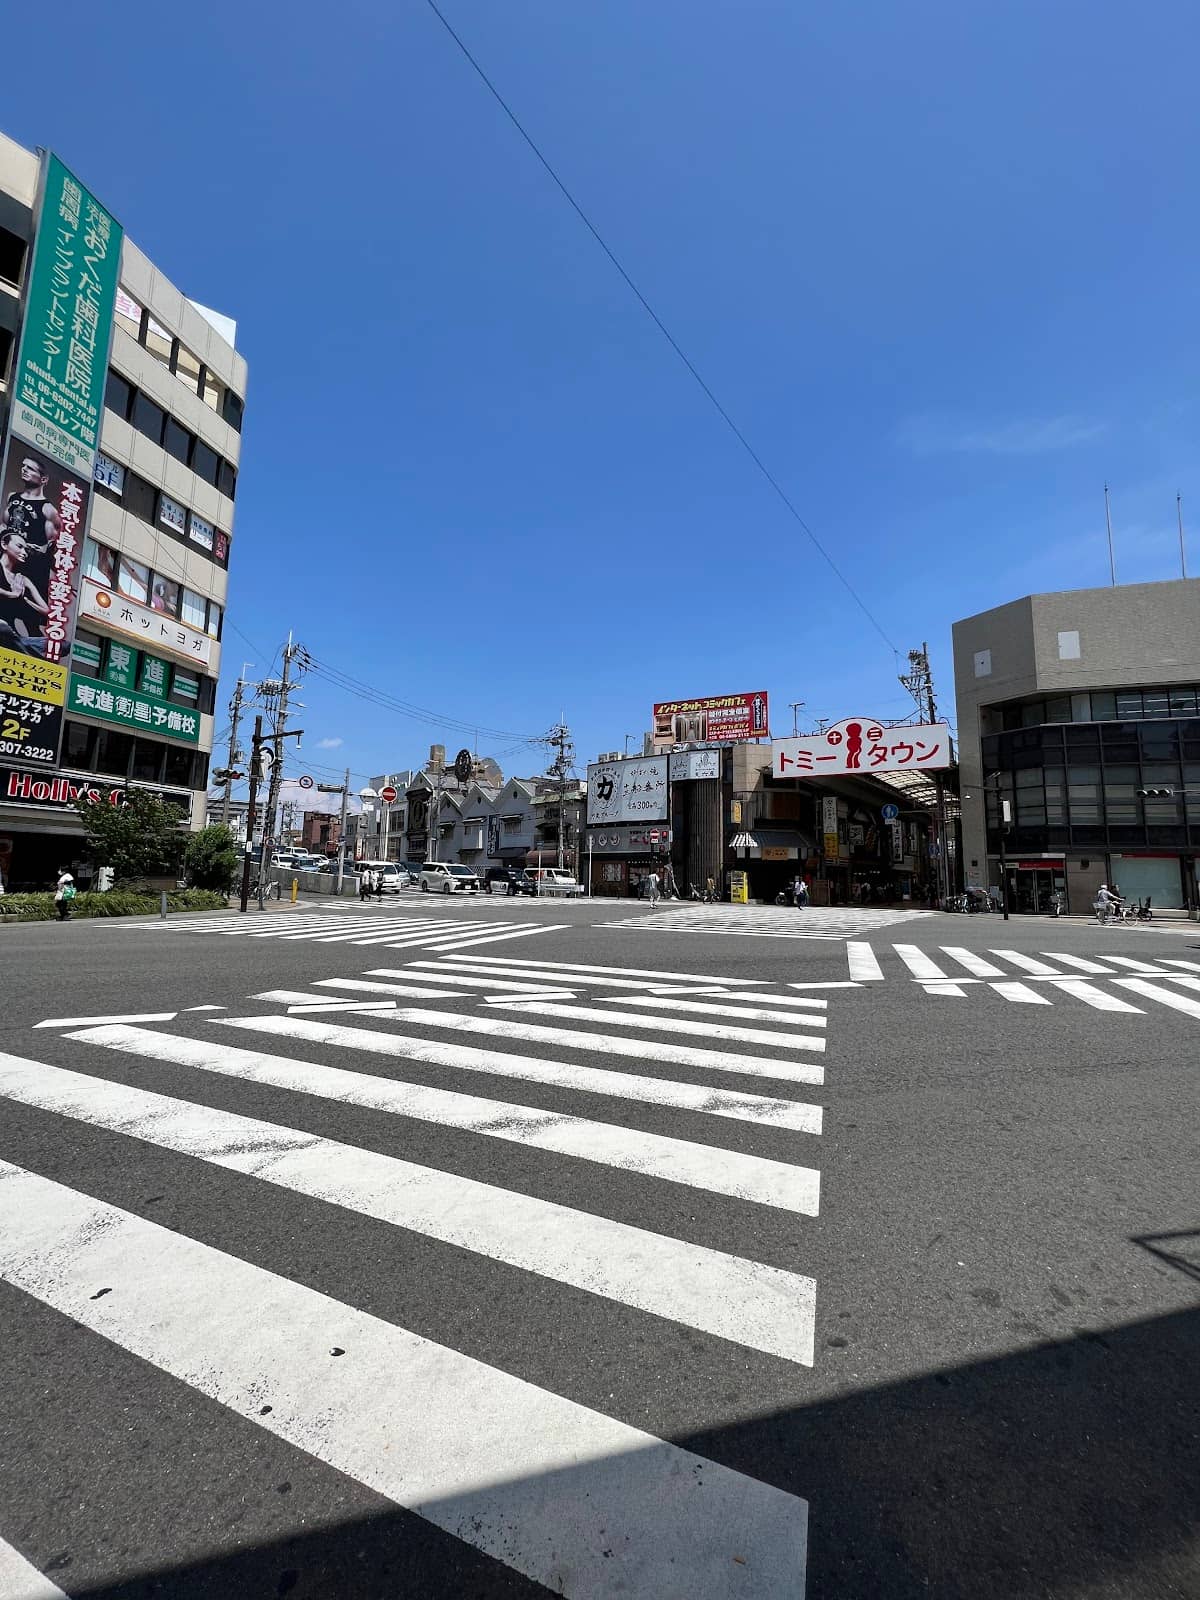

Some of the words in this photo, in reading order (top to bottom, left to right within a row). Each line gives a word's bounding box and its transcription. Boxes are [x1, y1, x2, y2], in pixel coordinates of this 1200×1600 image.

[59, 177, 83, 231] 歯周病
[43, 227, 75, 371] インプラントセンター
[65, 226, 108, 398] おくだ歯科医院
[21, 409, 91, 464] 歯周病専門医
[35, 432, 76, 466] CT完備
[120, 608, 203, 651] ホットヨガ
[0, 656, 63, 678] ットネスクラブ
[141, 683, 163, 696] 予備校
[74, 683, 197, 736] 東進衛星予備校
[1, 719, 31, 741] 2F
[0, 741, 54, 761] 307-3222
[780, 750, 838, 772] トミー
[867, 741, 940, 766] タウン
[7, 772, 102, 807] Holly's
[597, 775, 614, 801] 力
